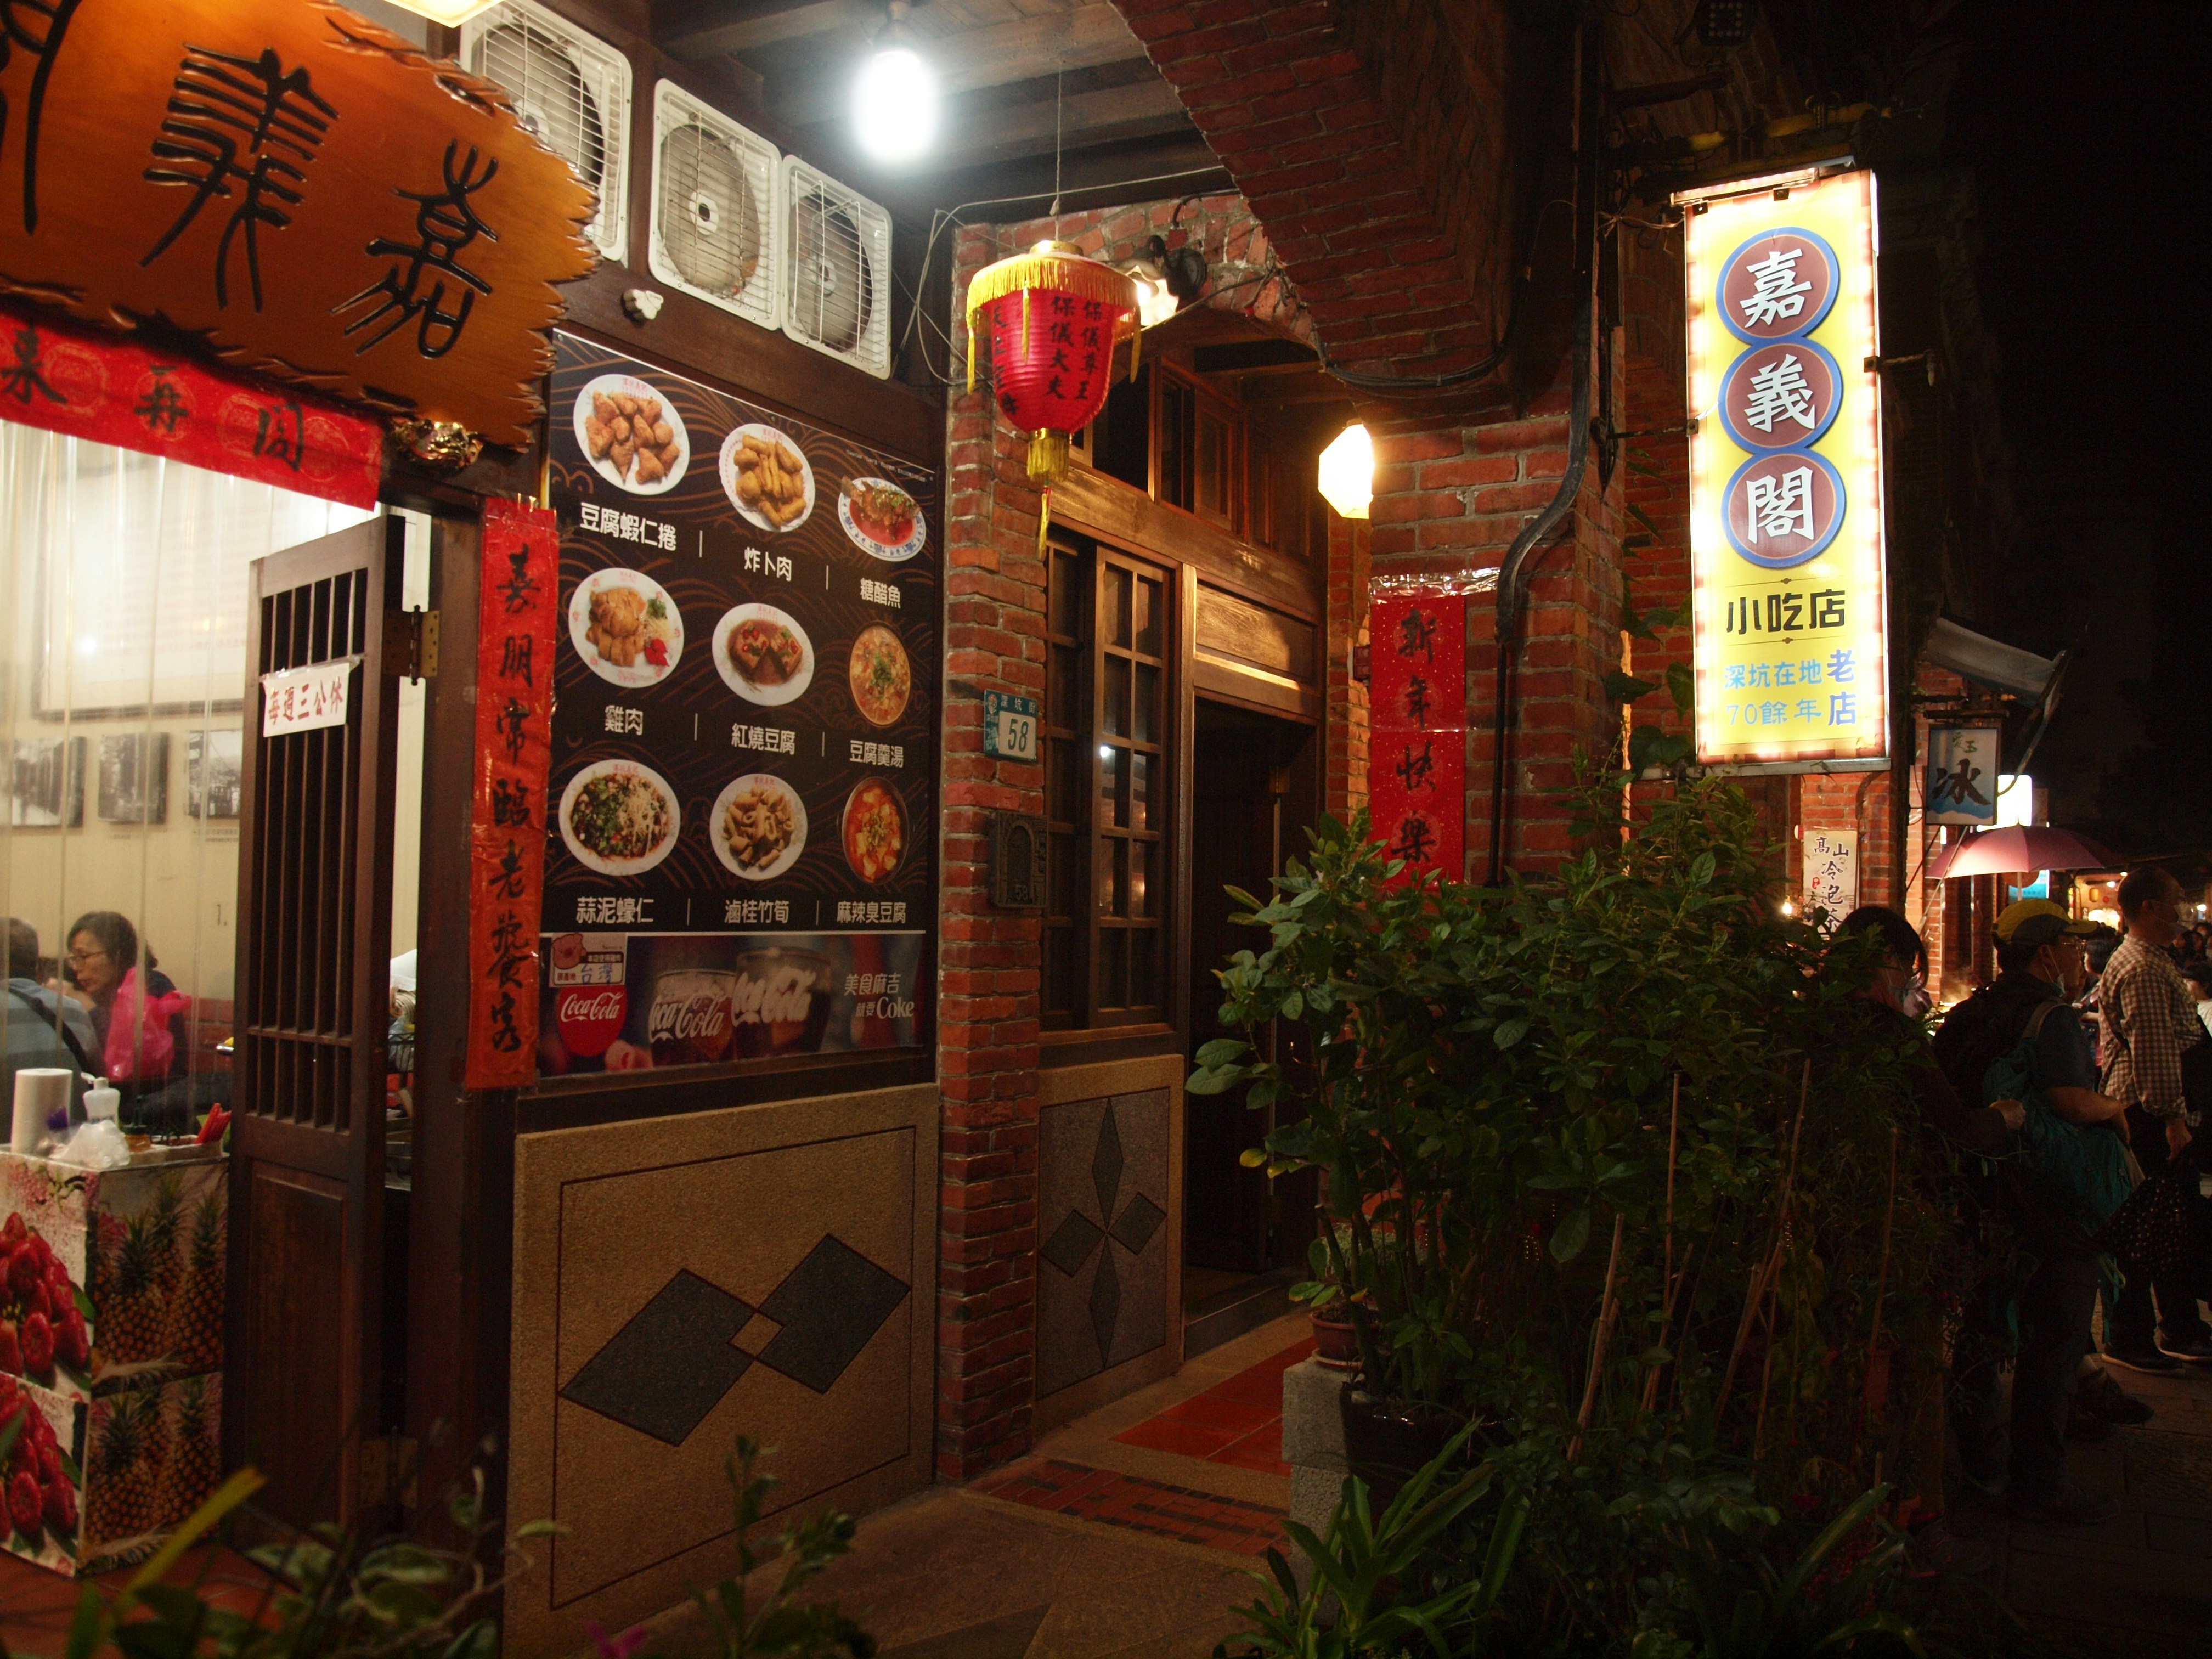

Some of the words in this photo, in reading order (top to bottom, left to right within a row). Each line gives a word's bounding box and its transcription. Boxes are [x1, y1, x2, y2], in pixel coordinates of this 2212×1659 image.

[1740, 247, 1816, 545] 嘉義閣
[580, 502, 676, 551] 豆腐蝦仁捲
[744, 546, 792, 582] 炸卜肉
[860, 577, 901, 609] 糖醋魚
[1725, 588, 1846, 635] 小吃店
[605, 704, 643, 735] 雞肉
[1008, 718, 1029, 752] 58
[1391, 608, 1438, 863] 新年快樂
[731, 723, 795, 755] 紅燒豆腐
[850, 740, 904, 768] 豆腐羹湯
[1932, 758, 1991, 805] 冰
[576, 896, 654, 924] 蒜泥蠔仁
[724, 899, 789, 924] 滷桂竹筍
[837, 900, 906, 924] 麻辣臭豆腐
[844, 972, 901, 996] 美食麻吉
[561, 992, 623, 1022] Coca-Cola
[877, 996, 915, 1019] Coke
